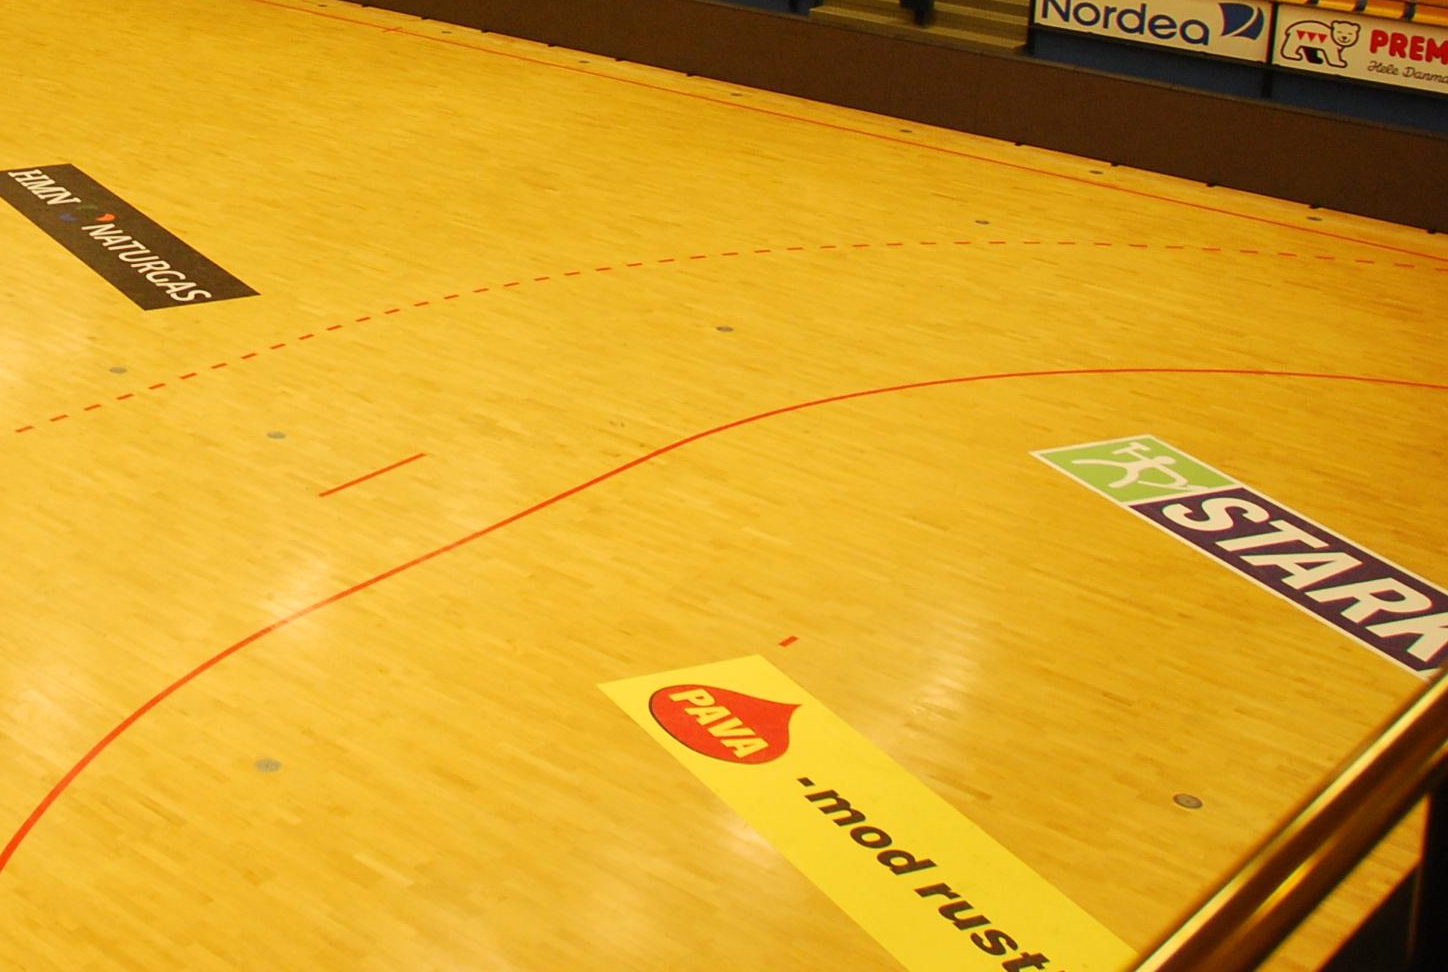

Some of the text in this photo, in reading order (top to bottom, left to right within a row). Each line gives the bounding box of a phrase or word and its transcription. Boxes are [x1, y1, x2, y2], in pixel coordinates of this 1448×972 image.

[1369, 29, 1448, 65] PREM
[8, 169, 81, 205] HMN
[81, 223, 212, 303] NATURGAS
[1162, 497, 1448, 663] STARK
[668, 688, 769, 759] PAVA
